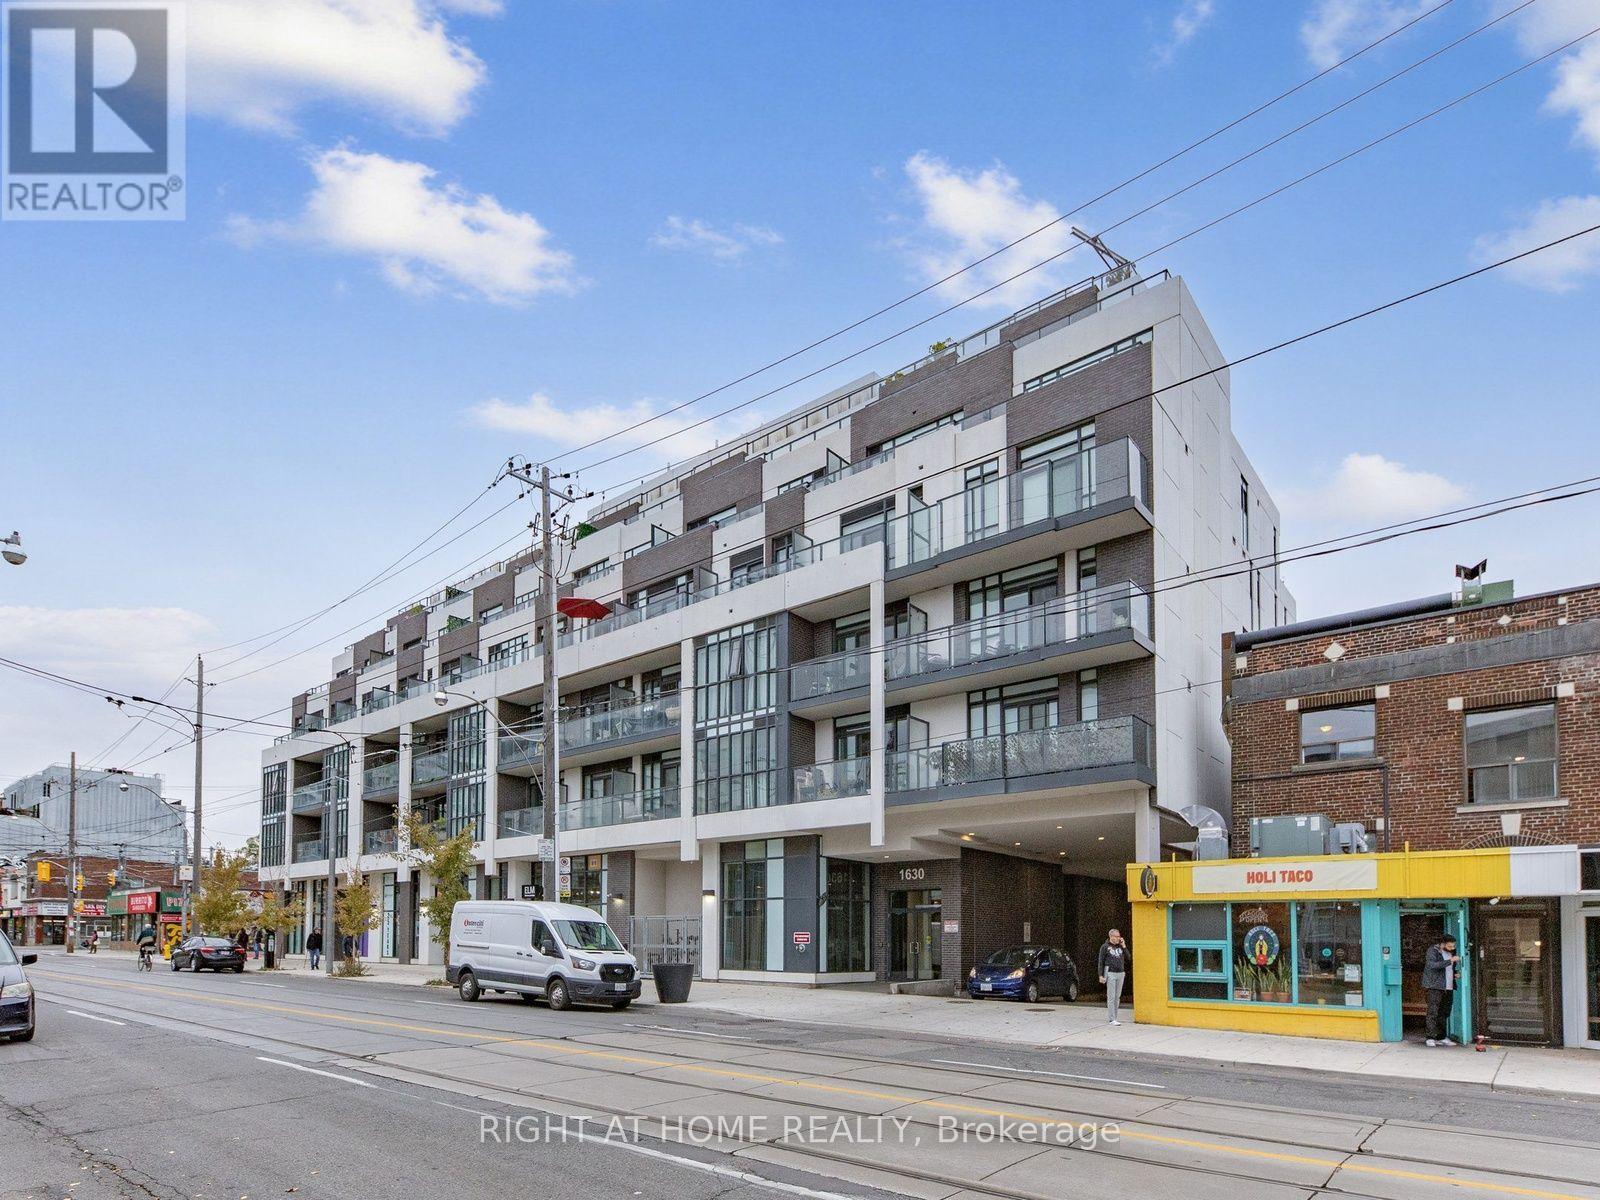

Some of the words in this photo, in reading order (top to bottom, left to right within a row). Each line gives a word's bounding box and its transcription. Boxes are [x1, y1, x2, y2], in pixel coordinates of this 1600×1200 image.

[899, 868, 925, 880] 1630
[1247, 871, 1276, 884] HOLI
[1280, 870, 1313, 883] TACO
[524, 886, 535, 894] ELM
